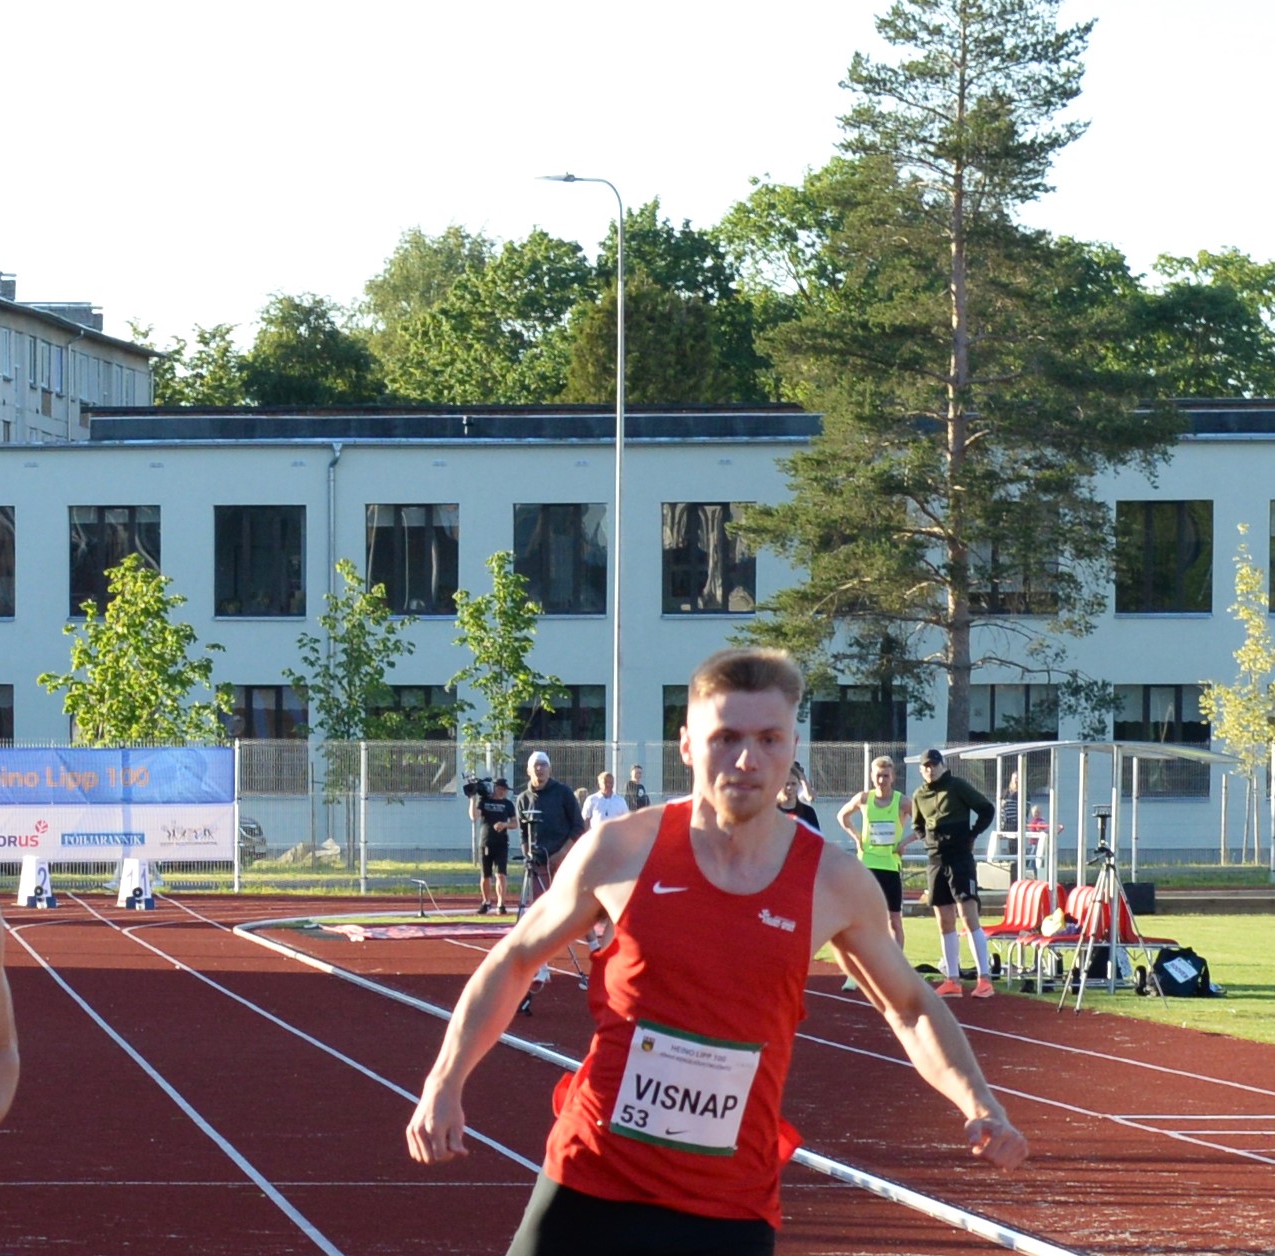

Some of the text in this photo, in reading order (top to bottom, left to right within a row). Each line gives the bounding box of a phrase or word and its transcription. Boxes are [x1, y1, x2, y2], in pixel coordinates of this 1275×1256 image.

[46, 766, 99, 792] Lipp
[107, 767, 150, 788] 100
[37, 866, 48, 895] 2
[140, 867, 148, 896] 1
[671, 1044, 696, 1057] HEINO
[696, 1050, 713, 1060] LIPP
[714, 1054, 727, 1063] 100
[634, 1073, 739, 1120] VISNAP
[620, 1105, 650, 1129] 53
